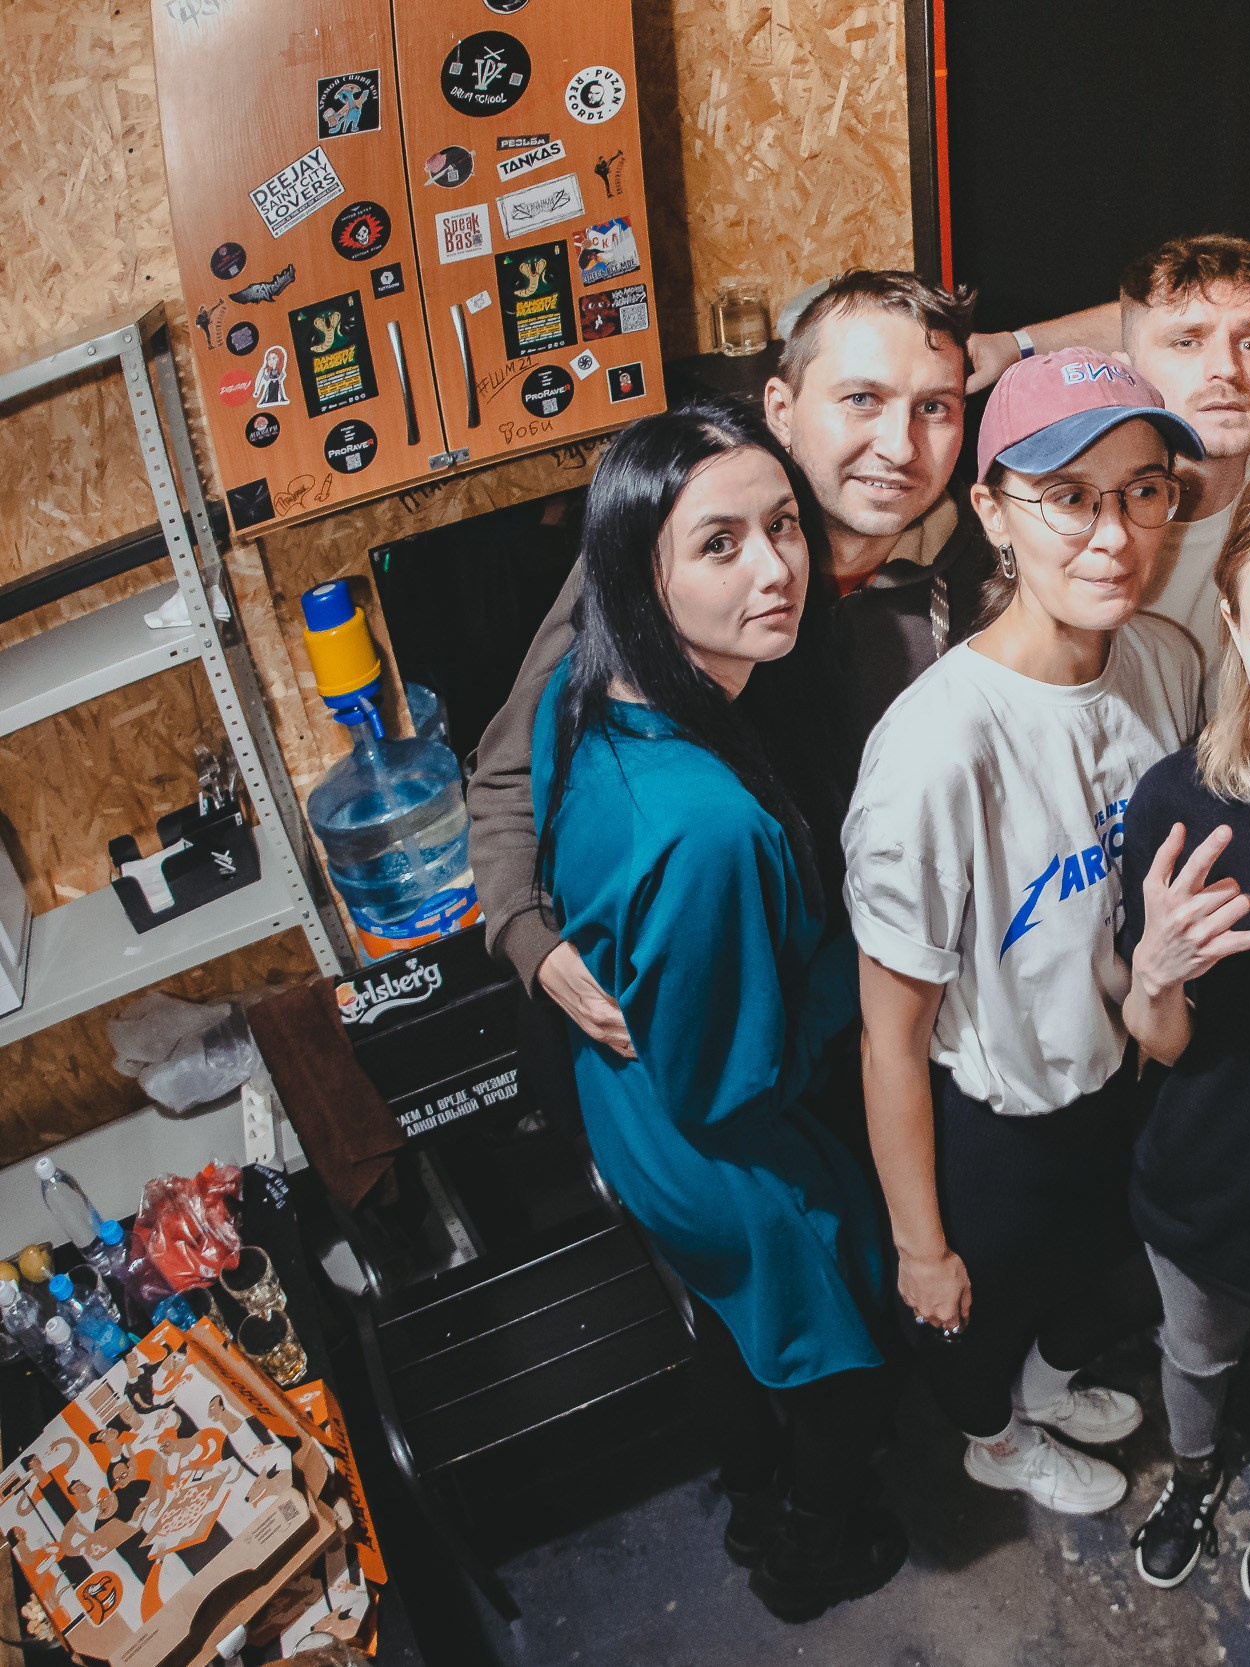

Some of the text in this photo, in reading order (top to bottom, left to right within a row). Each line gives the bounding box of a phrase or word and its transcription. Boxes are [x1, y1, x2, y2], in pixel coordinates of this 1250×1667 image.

[450, 86, 507, 104] DRUM SCHOOL
[569, 77, 603, 120] RECORDZ
[595, 69, 622, 105] PUZAN
[252, 149, 323, 206] DEEJAY
[500, 143, 561, 175] TANKAS
[261, 184, 299, 215] SAINT
[300, 163, 328, 187] CITY
[265, 172, 336, 226] LOVERS
[443, 212, 480, 235] Speak
[1061, 362, 1136, 387] БИЧ
[397, 1108, 422, 1128] АЕМ
[437, 1089, 469, 1110] ВРЕДЕ
[472, 1069, 518, 1096] ЧРЕЗМЕР
[406, 1083, 518, 1137] АЛКОГОЛЬНОЙ ПРОДУ
